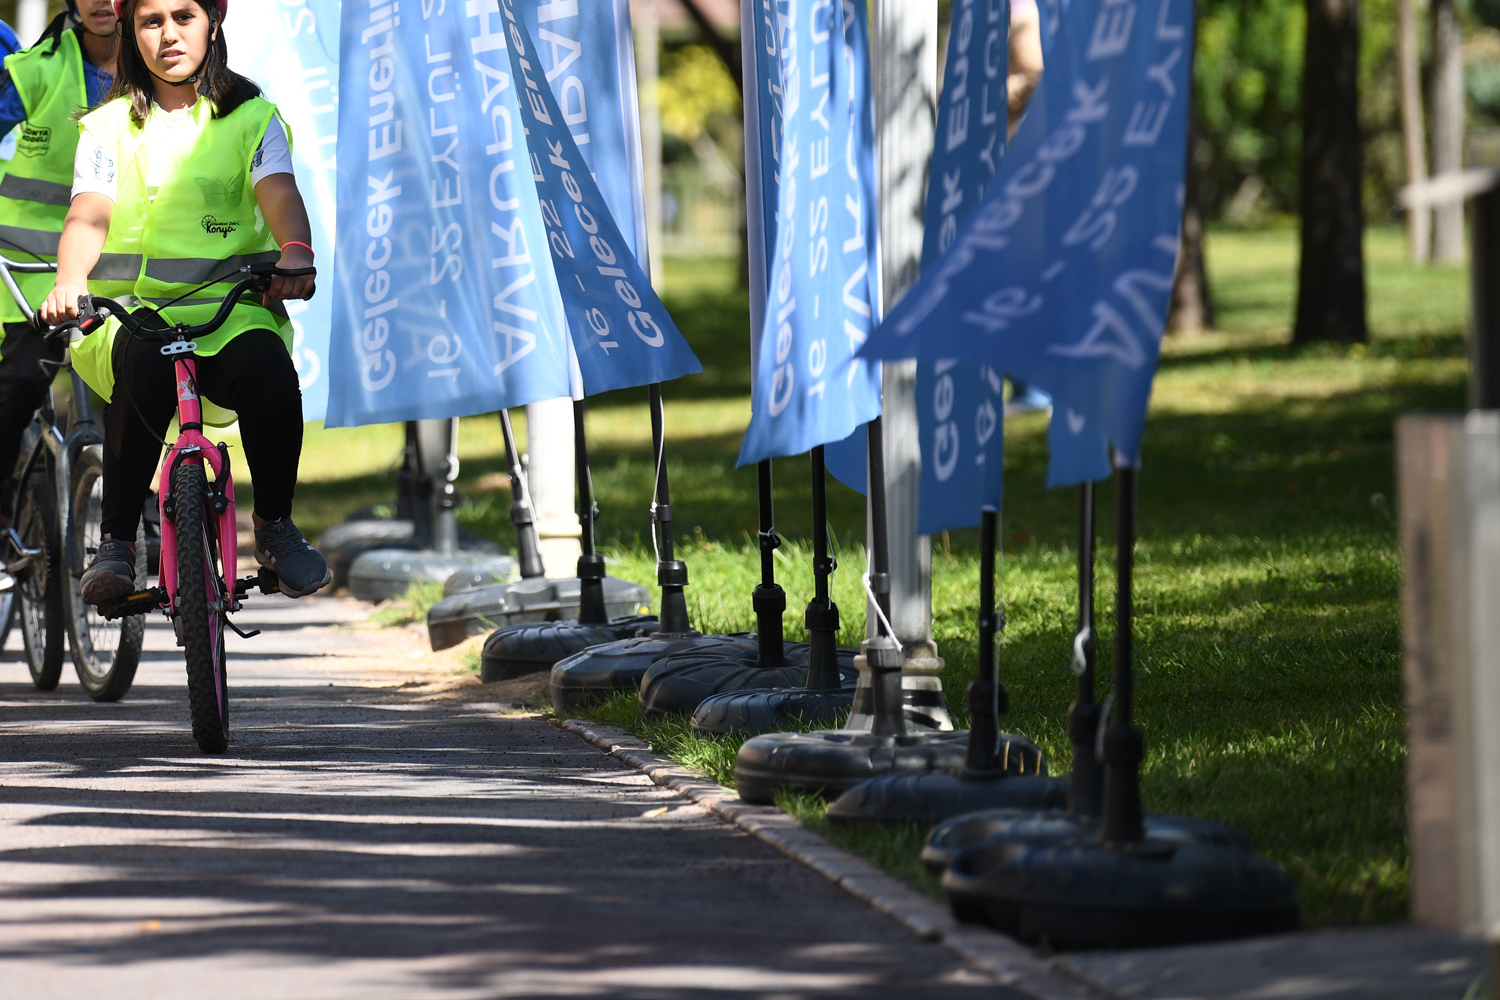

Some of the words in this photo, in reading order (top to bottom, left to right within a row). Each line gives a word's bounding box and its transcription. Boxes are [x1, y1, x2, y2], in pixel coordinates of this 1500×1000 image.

[206, 221, 237, 239] Konya
[539, 198, 577, 259] 22
[545, 136, 666, 349] Gelecek
